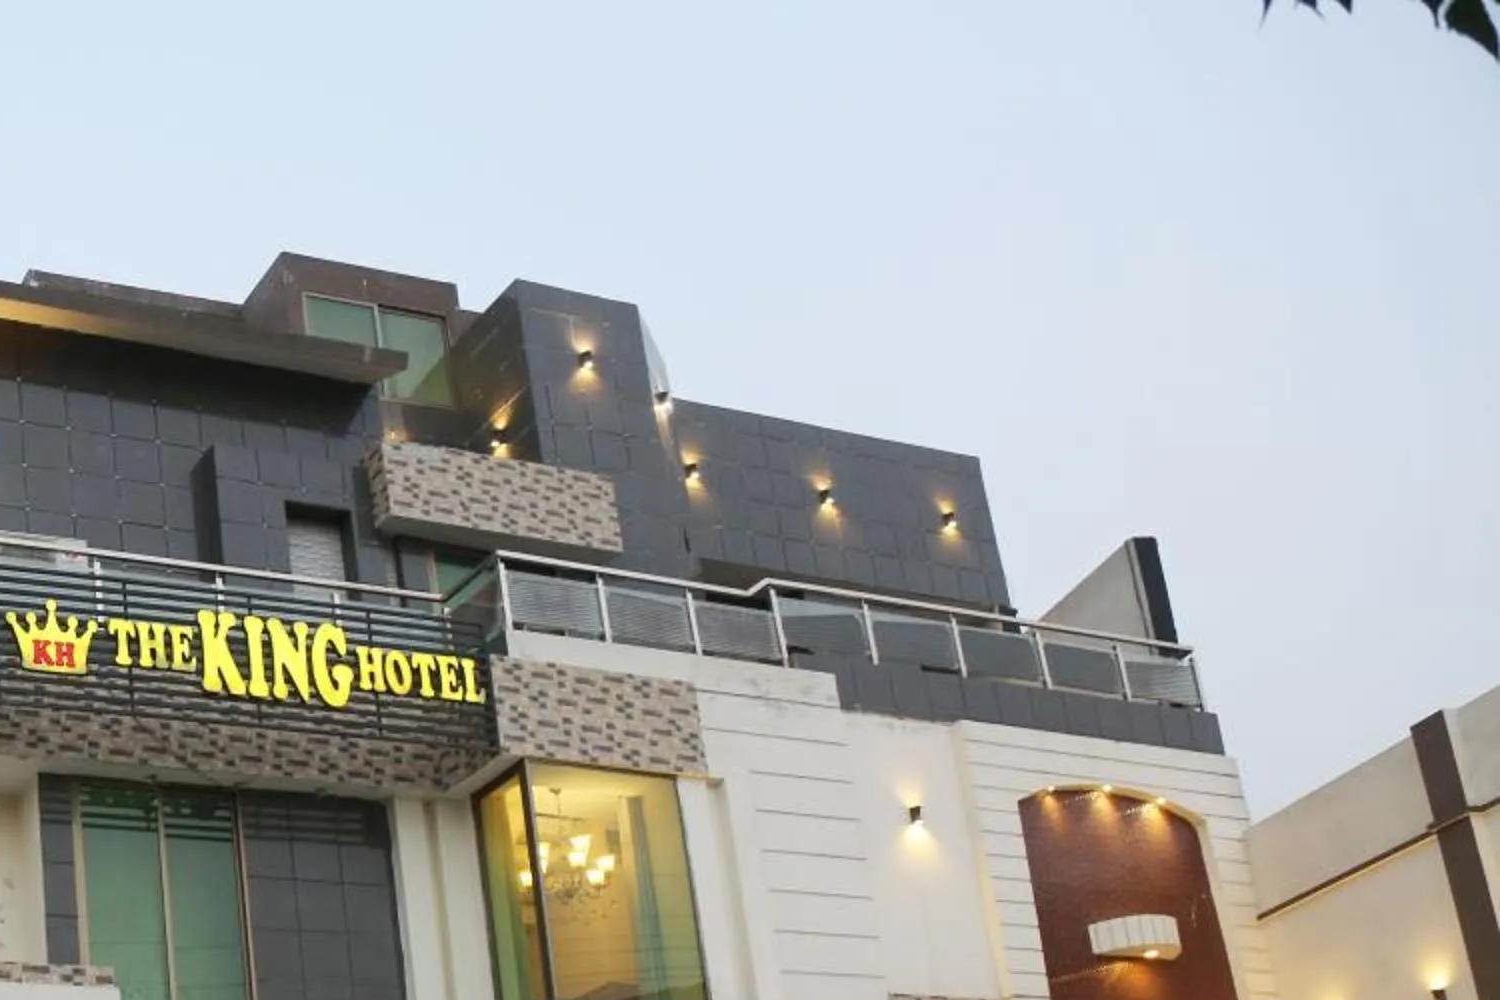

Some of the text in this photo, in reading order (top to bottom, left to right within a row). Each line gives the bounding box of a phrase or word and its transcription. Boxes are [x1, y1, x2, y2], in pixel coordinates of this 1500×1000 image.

[32, 639, 76, 668] KH
[108, 610, 486, 707] THE KING HOTEL
